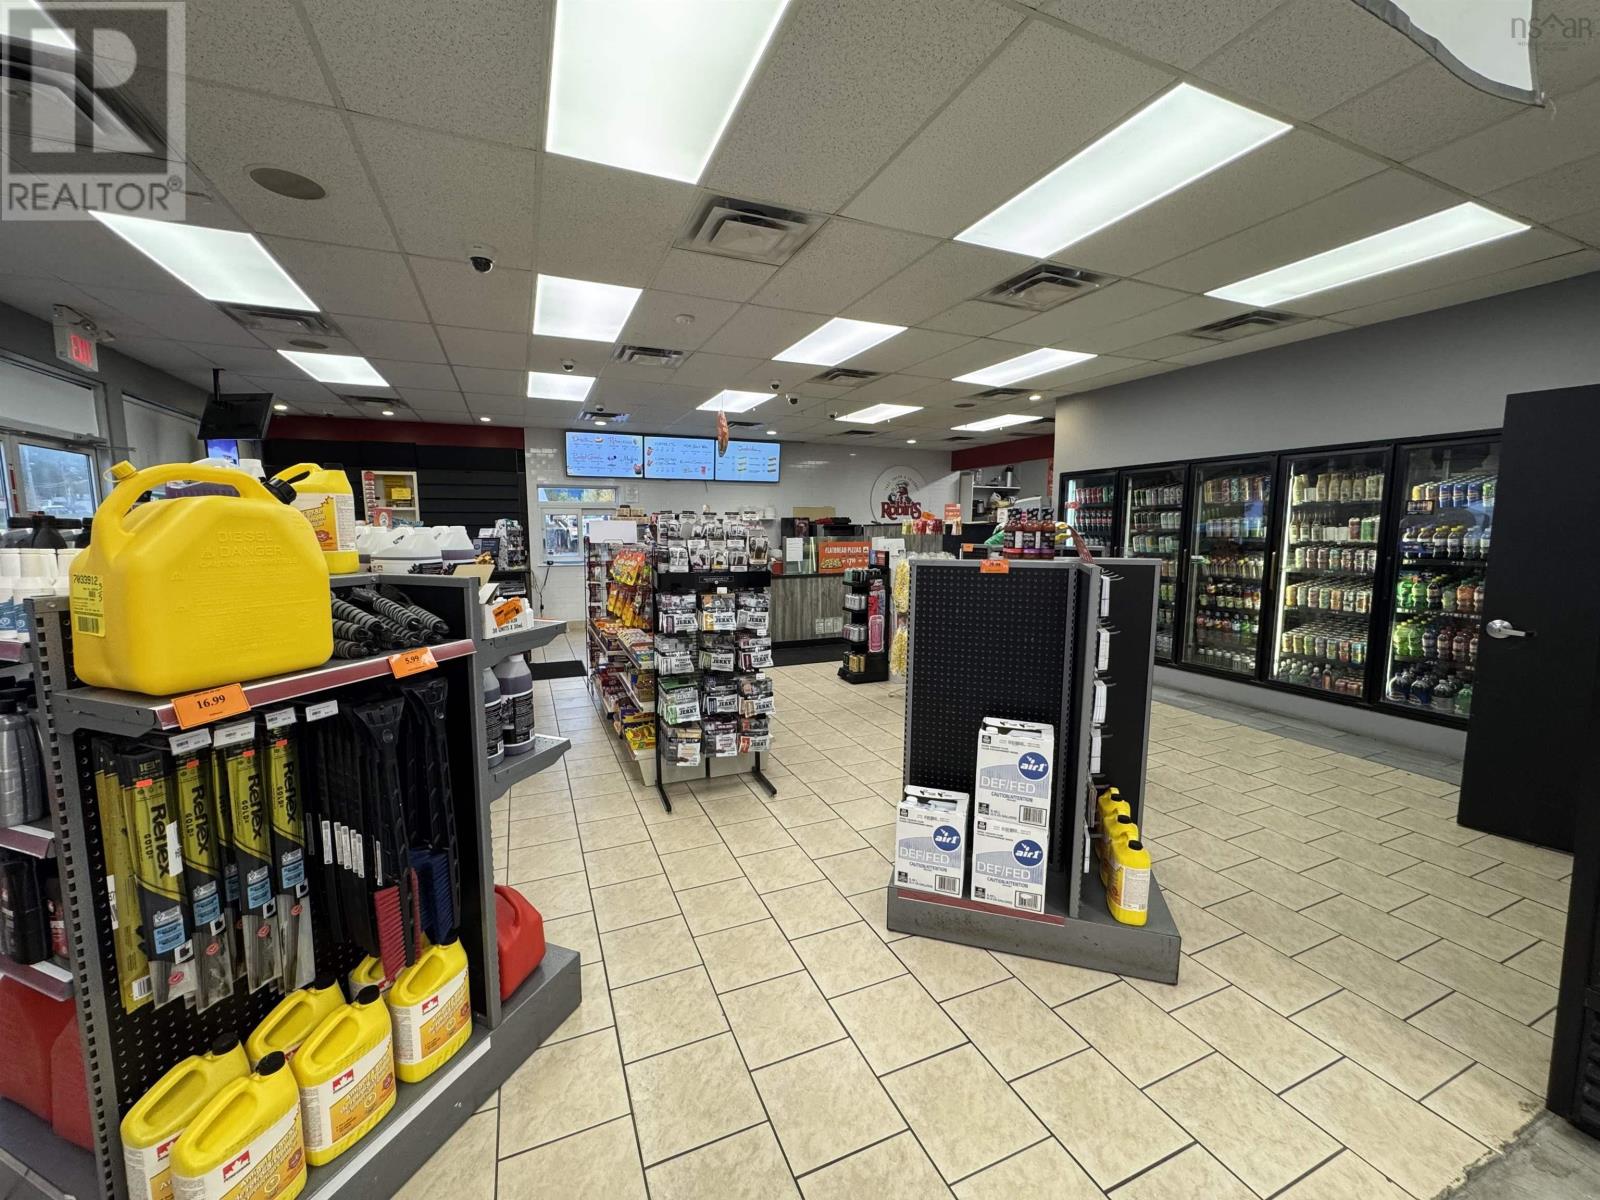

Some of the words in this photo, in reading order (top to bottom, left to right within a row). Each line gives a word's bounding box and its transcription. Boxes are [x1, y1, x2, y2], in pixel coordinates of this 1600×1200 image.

[404, 655, 420, 665] 5.99
[197, 694, 226, 709] 16.99
[980, 775, 1037, 794] DEF/FED
[899, 846, 951, 865] DEF/FED
[975, 860, 1032, 880] DEF/FED
